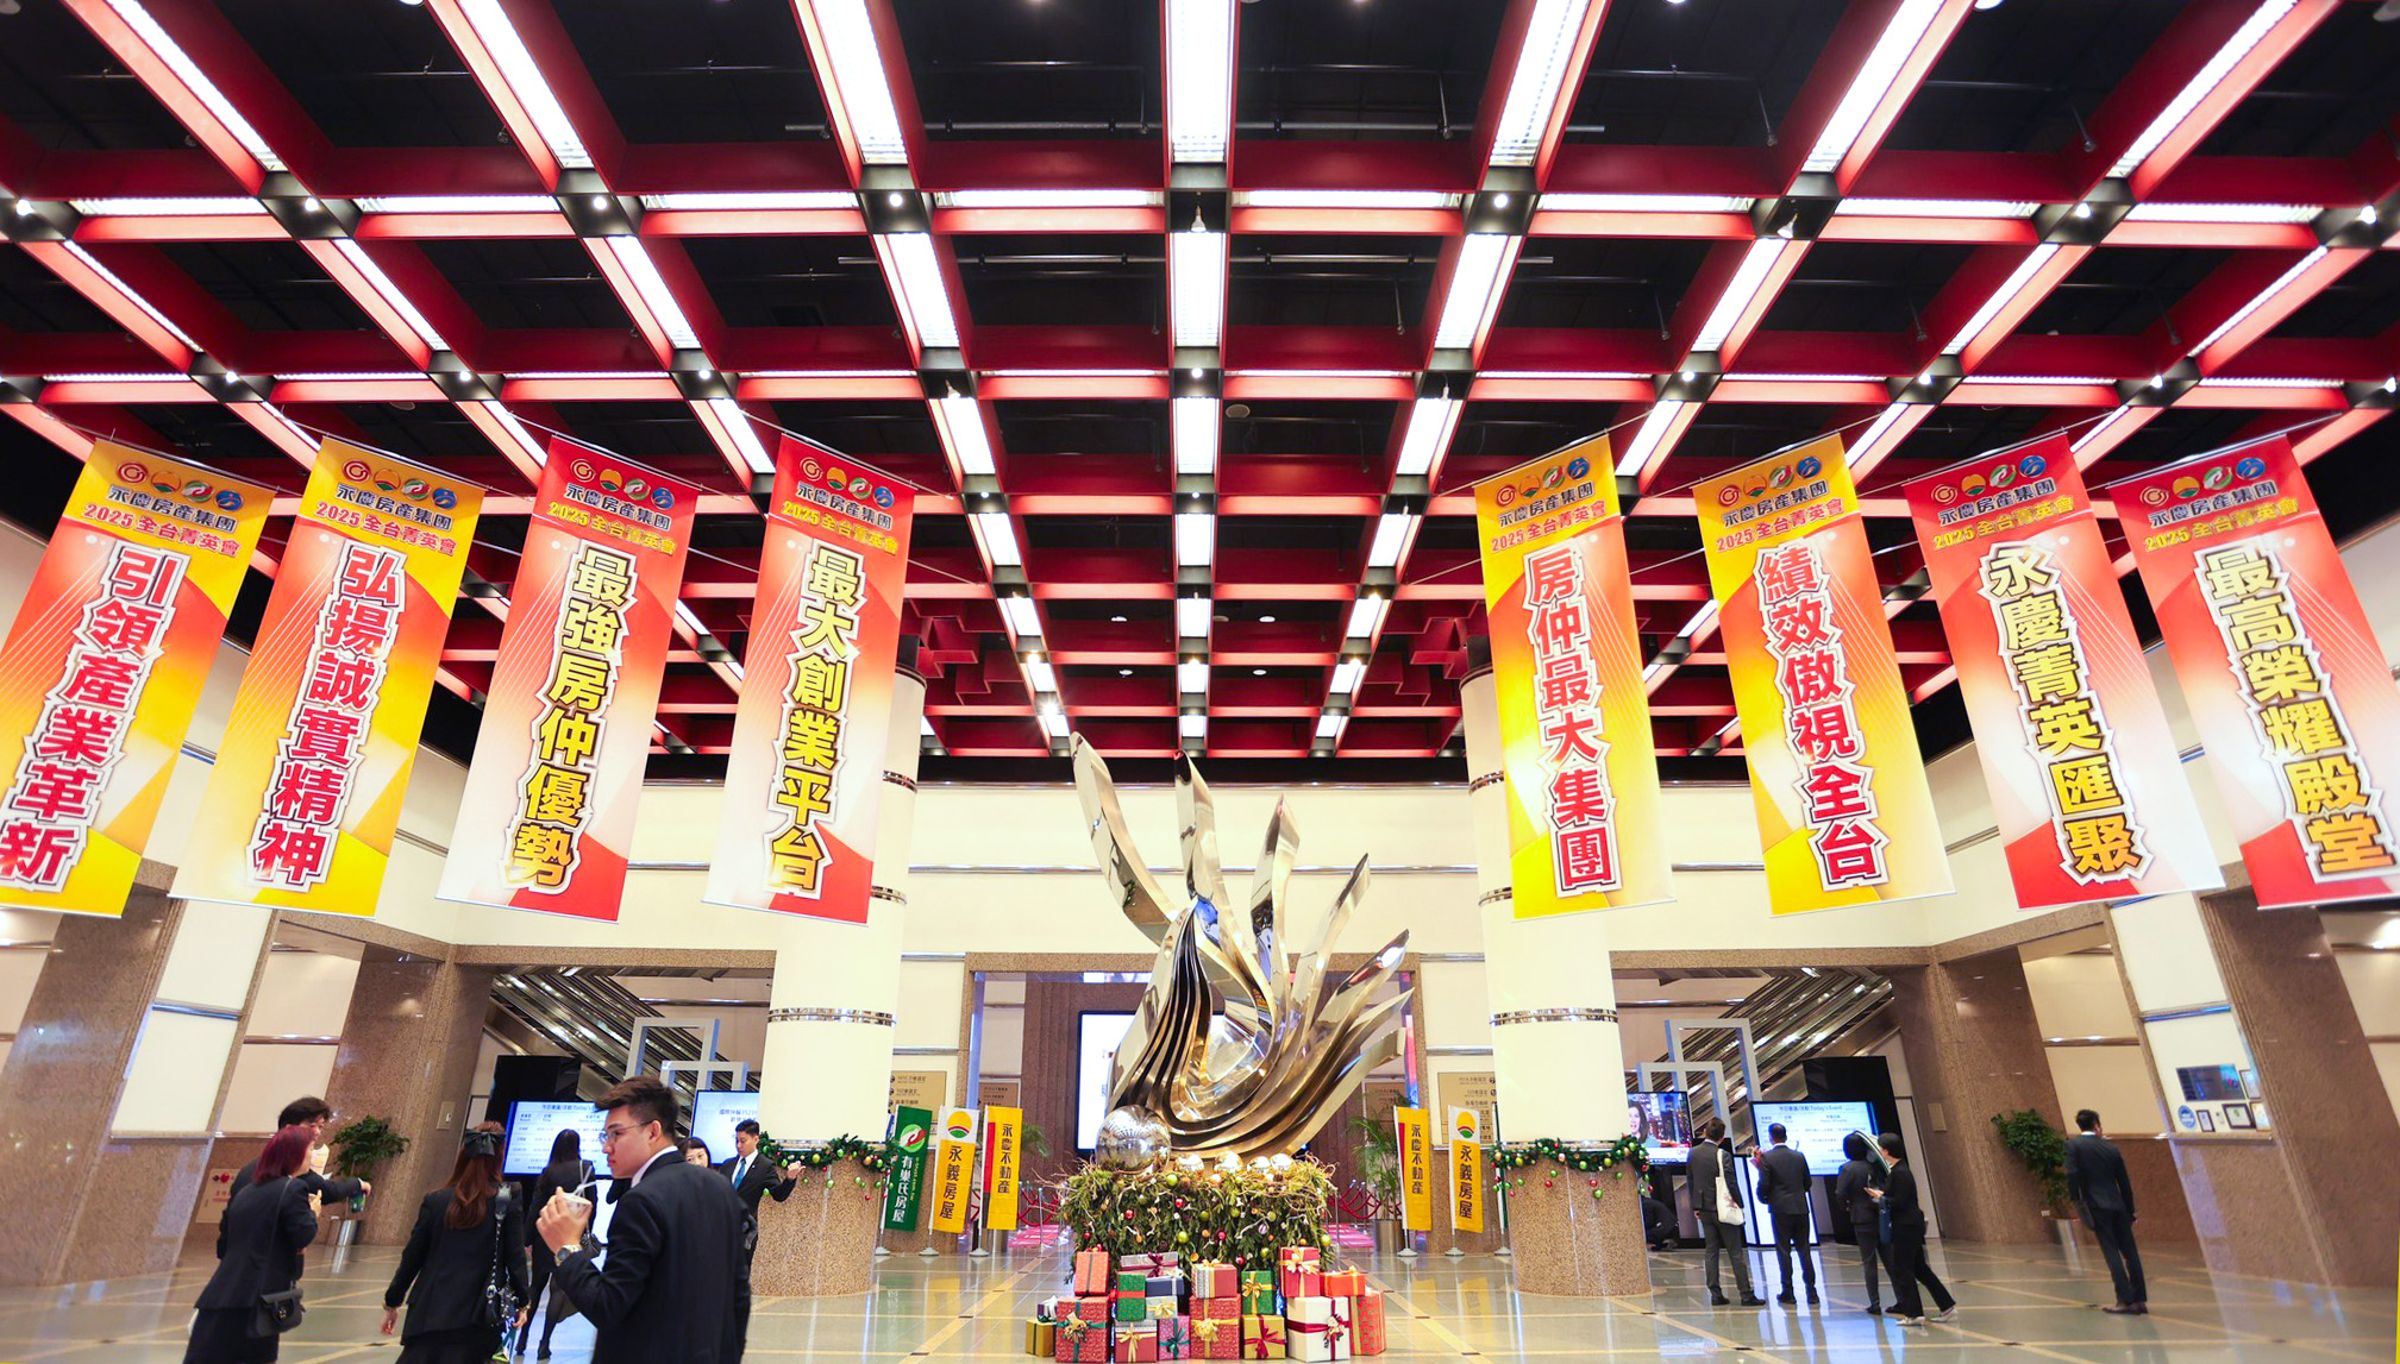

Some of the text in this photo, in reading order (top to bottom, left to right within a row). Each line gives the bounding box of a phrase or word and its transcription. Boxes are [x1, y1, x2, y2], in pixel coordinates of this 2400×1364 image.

[108, 485, 238, 532] 永慶房產集團
[315, 501, 457, 556] 2025 全台菁英會
[336, 483, 453, 531] 永慶房產集團
[547, 502, 589, 527] 2025
[564, 483, 671, 531] 永慶房產集團
[782, 500, 820, 525] 2025
[796, 481, 893, 531] 永慶房產集團
[1491, 500, 1606, 553] 2025 全台菁英會
[1498, 482, 1594, 528] 永慶房產集團
[1716, 498, 1844, 553] 2025 全台菁英會
[1723, 480, 1828, 528] 永慶房產集團
[1938, 477, 2056, 527] 永慶房產集團
[2148, 480, 2278, 528] 永慶房產集團
[84, 503, 240, 557] 2025 全台菁英會
[1933, 526, 1975, 550] 2025
[2144, 527, 2191, 553] 2025
[0, 546, 184, 886] 引領產業革新
[254, 546, 402, 887] 弘揚誠實精神
[506, 545, 633, 888] 最強房仲優勢
[770, 545, 862, 892] 最大創業平台
[1529, 547, 1615, 890] 房仲最大集團
[1760, 544, 1882, 885] 績效傲視全台
[1987, 545, 2142, 876] 永慶菁英匯聚
[2204, 546, 2398, 874] 最高榮耀殿堂
[939, 1145, 962, 1220] 永義房屋
[997, 1123, 1012, 1194] 永慶不動產
[1411, 1124, 1424, 1195] 永慶不動產
[1459, 1145, 1473, 1219] 永義房屋
